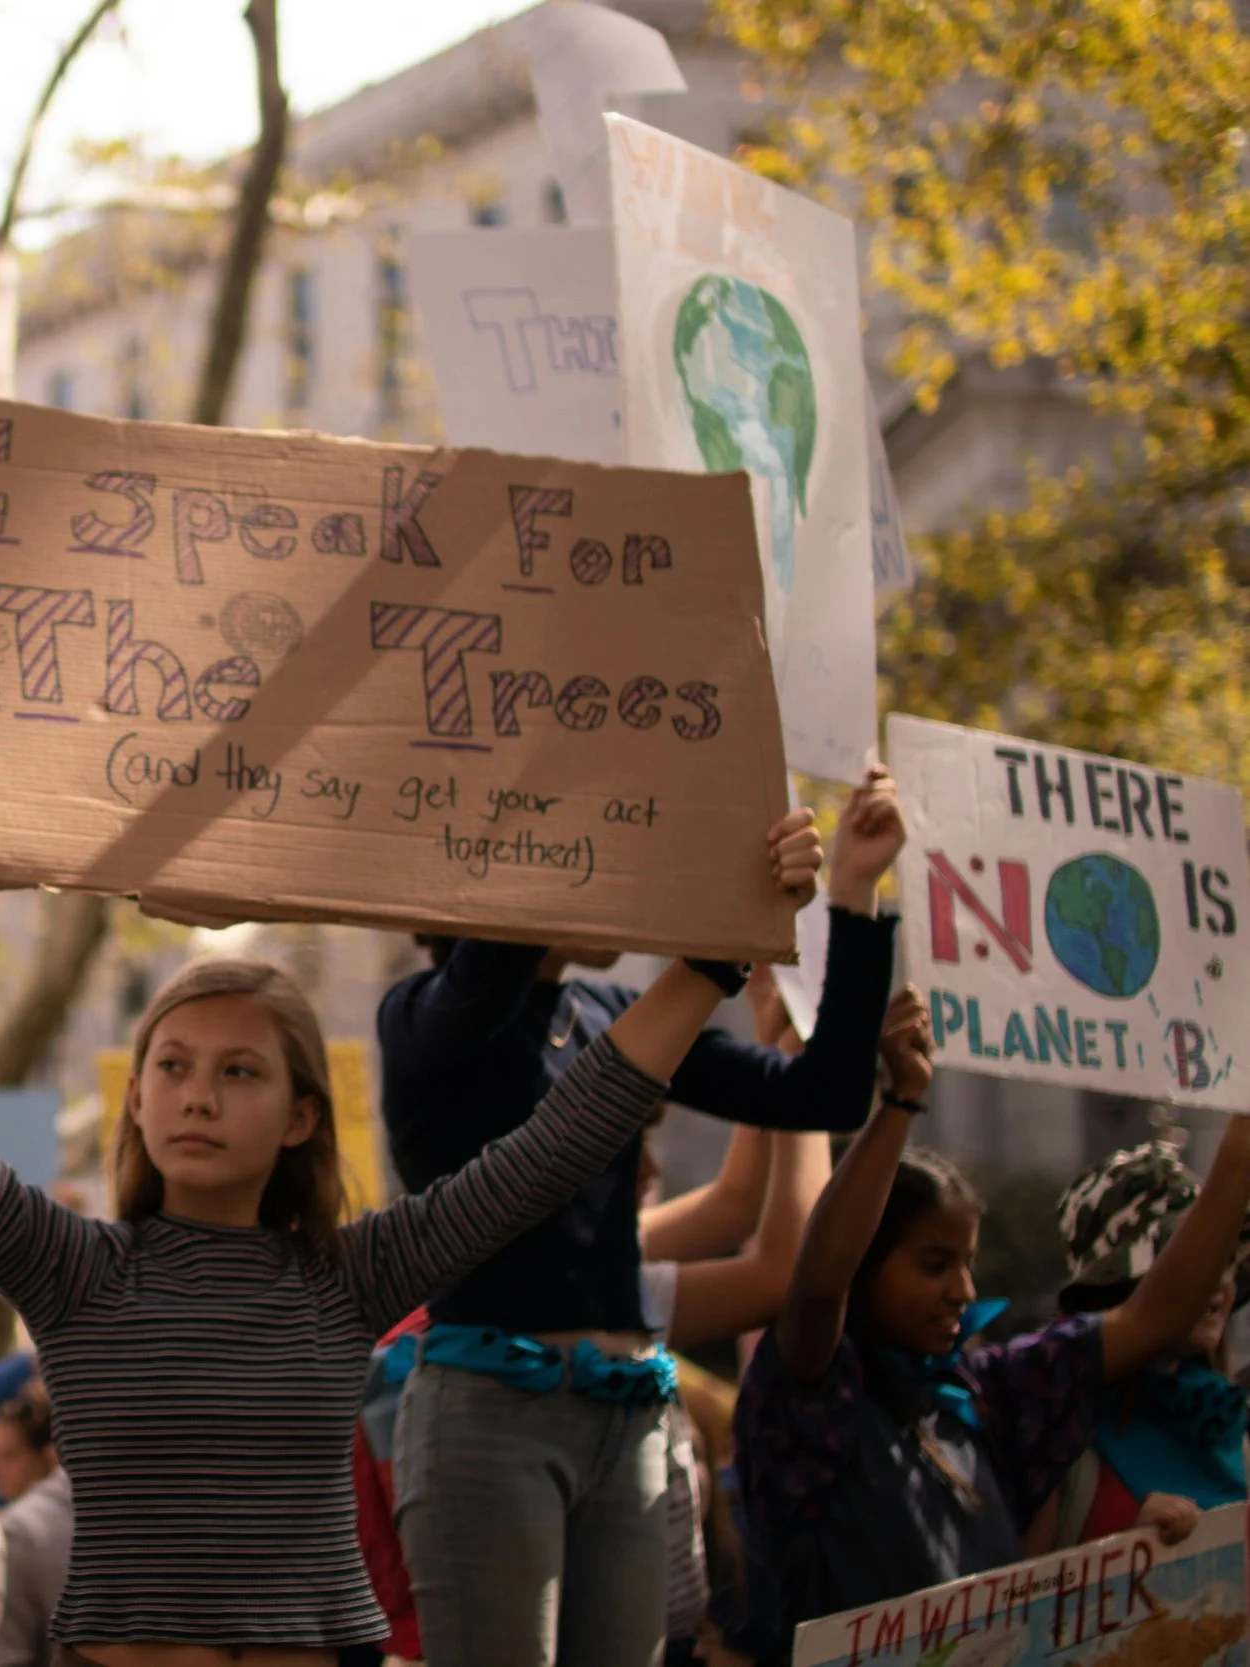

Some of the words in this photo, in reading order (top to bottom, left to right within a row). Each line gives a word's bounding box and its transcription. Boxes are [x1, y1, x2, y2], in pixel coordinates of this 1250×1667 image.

[509, 485, 672, 586] For
[370, 601, 722, 741] Trees
[215, 743, 281, 819] they
[301, 769, 361, 821] say
[392, 775, 456, 822] get
[485, 787, 562, 823] your
[604, 797, 660, 828] act
[994, 746, 1190, 844] THERE
[1182, 858, 1237, 938] IS
[929, 988, 1130, 1071] PLANET
[1170, 1019, 1212, 1092] B
[920, 1570, 1036, 1654] WITH
[1052, 1539, 1158, 1649] HER
